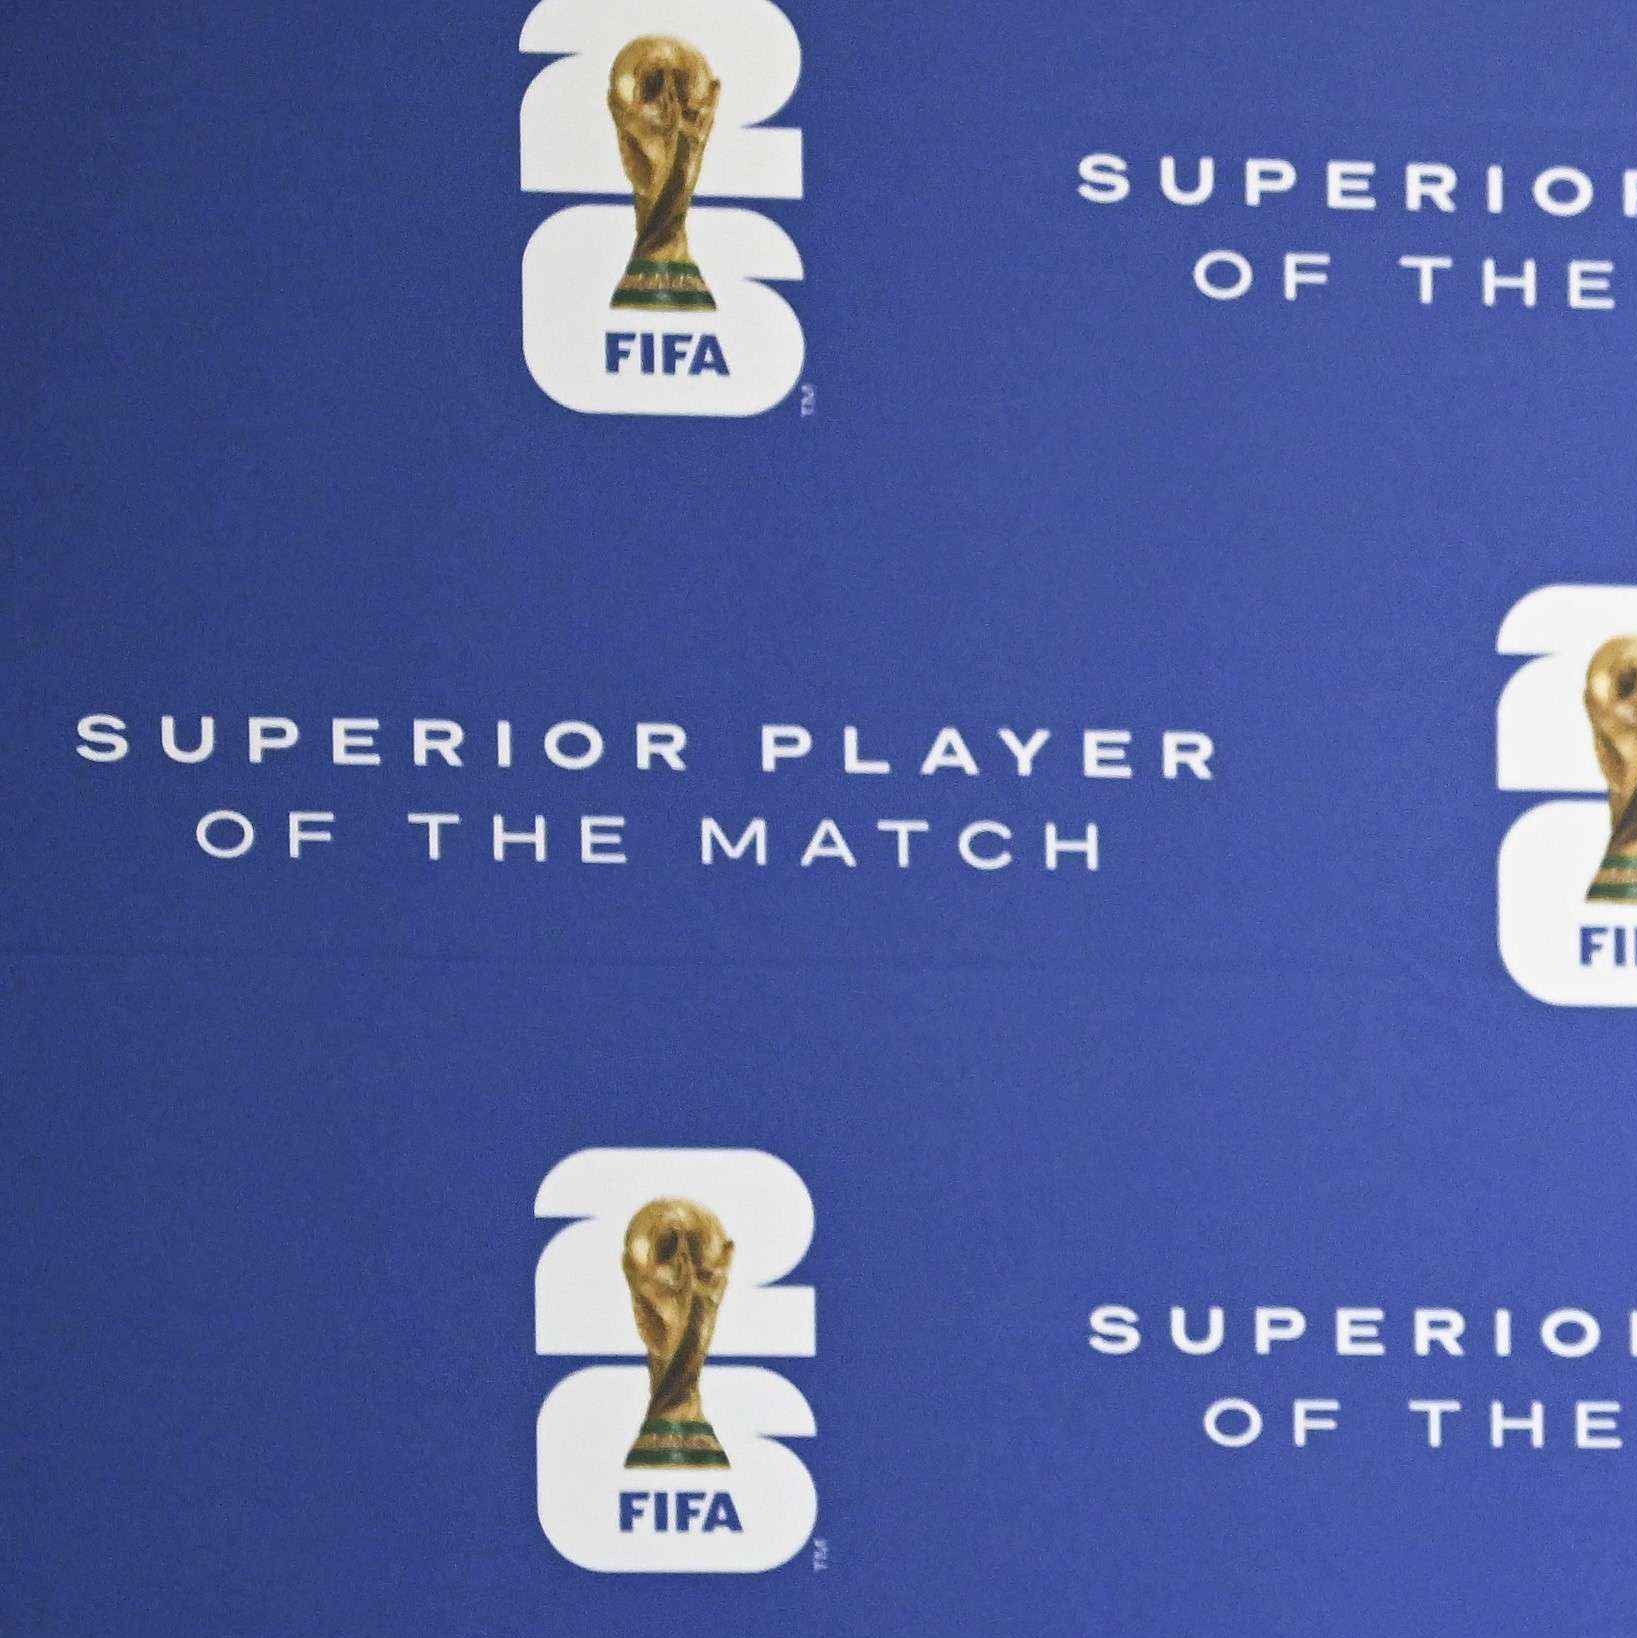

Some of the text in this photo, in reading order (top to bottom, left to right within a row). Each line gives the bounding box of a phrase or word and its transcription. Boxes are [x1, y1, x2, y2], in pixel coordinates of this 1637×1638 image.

[1192, 249, 1331, 302] OF
[1398, 254, 1616, 310] THE
[604, 331, 731, 377] FIFA
[76, 713, 1215, 781] SUPERIOR PLAYER
[195, 809, 1099, 872] OF THE MATCH
[1202, 1397, 1341, 1448] OF
[1407, 1398, 1624, 1450] THE
[618, 1490, 744, 1534] FIFA
